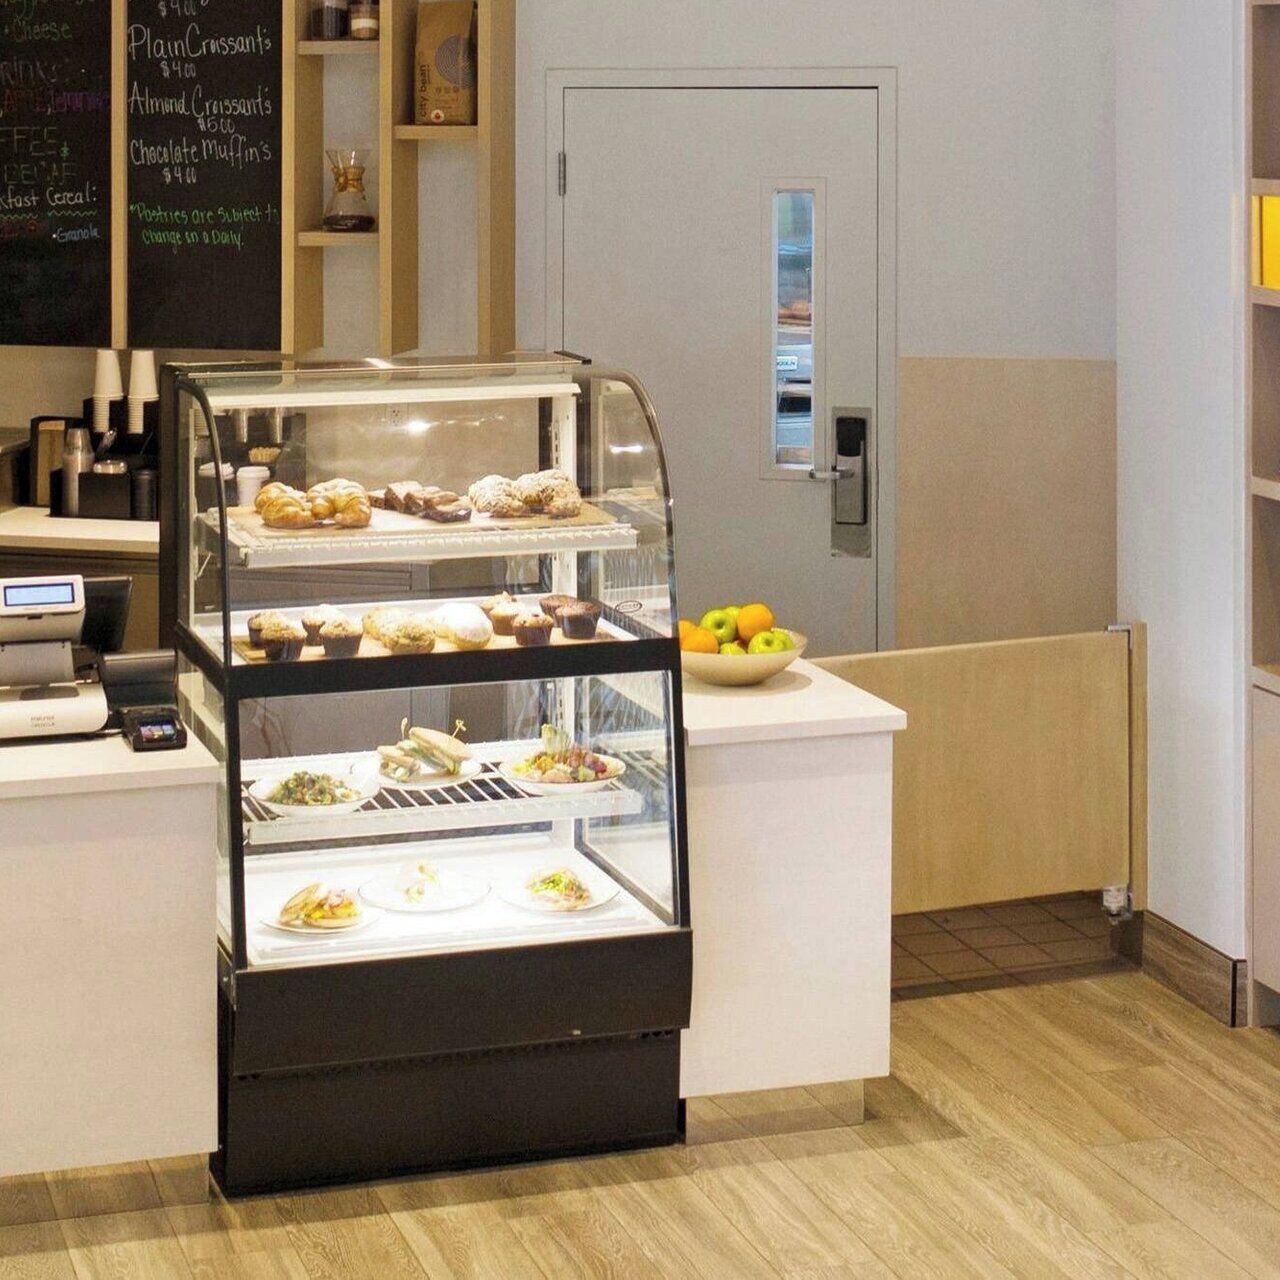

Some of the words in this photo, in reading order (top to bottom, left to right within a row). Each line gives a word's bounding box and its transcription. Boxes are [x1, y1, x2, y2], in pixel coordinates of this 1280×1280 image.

[128, 24, 187, 62] Plain
[186, 22, 272, 58] Croissant's
[419, 64, 428, 92] bean
[129, 80, 191, 116] Almond
[191, 83, 272, 118] Croissant's
[130, 136, 200, 166] Chocolate
[201, 133, 272, 171] Muffin's
[46, 181, 98, 206] Cereal:
